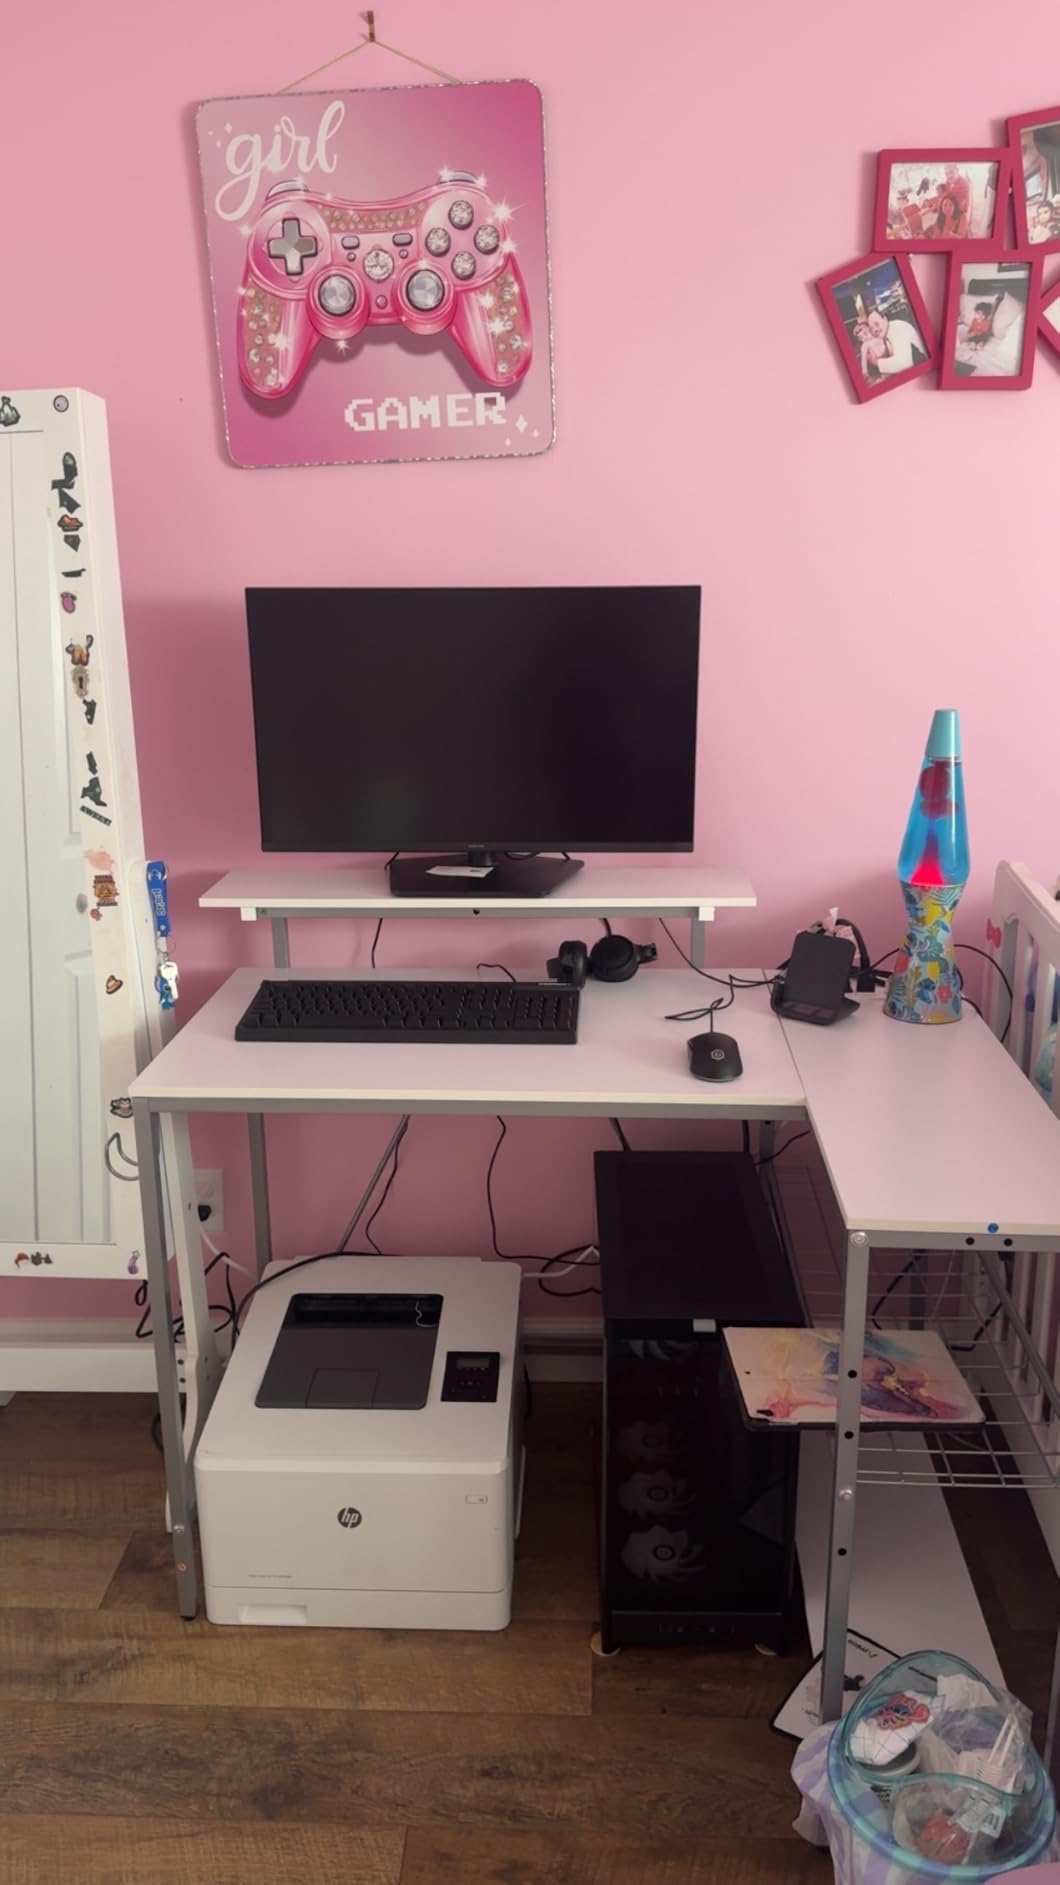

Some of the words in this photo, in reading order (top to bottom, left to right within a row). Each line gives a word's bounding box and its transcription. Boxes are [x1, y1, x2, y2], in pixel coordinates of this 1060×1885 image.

[215, 100, 345, 221] girl
[344, 392, 507, 432] GAMER
[338, 1506, 362, 1529] hp
